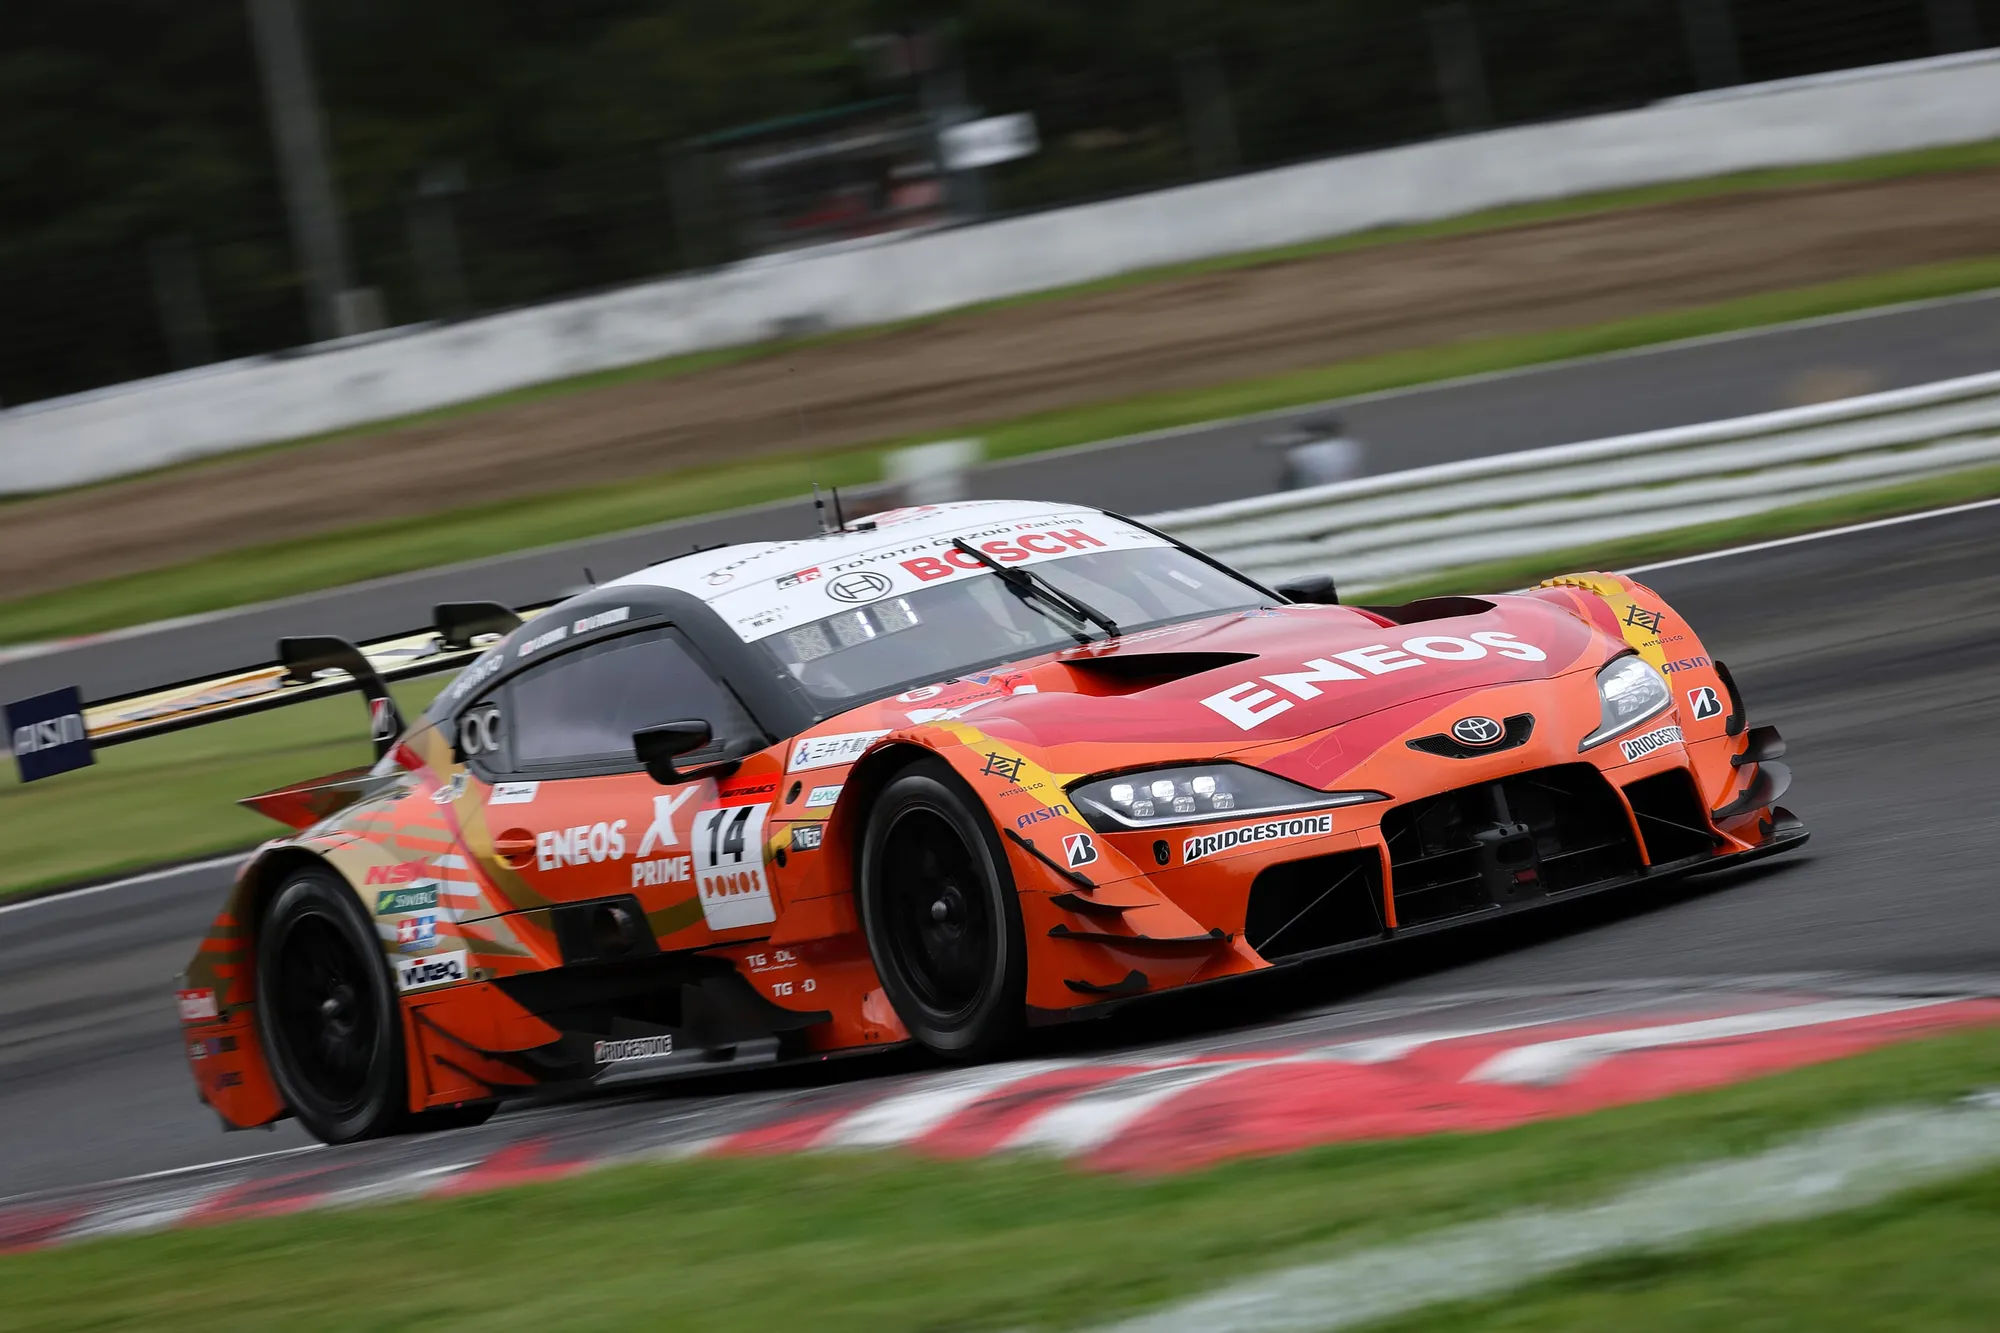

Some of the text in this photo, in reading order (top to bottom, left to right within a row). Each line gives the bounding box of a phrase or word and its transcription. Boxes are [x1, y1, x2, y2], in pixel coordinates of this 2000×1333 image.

[828, 544, 927, 573] TOYOTA
[1014, 516, 1084, 531] Racing
[899, 528, 1108, 582] BOSCH
[1199, 631, 1548, 731] ENEOS
[1661, 656, 1712, 675] AISIN
[719, 783, 777, 799] AUTOBACS
[1016, 804, 1070, 829] AISIN
[536, 819, 628, 872] ENEOS
[635, 785, 701, 858] X
[706, 806, 756, 867] 14
[1185, 816, 1330, 863] BRIDGESTONE
[631, 855, 691, 888] PRIME
